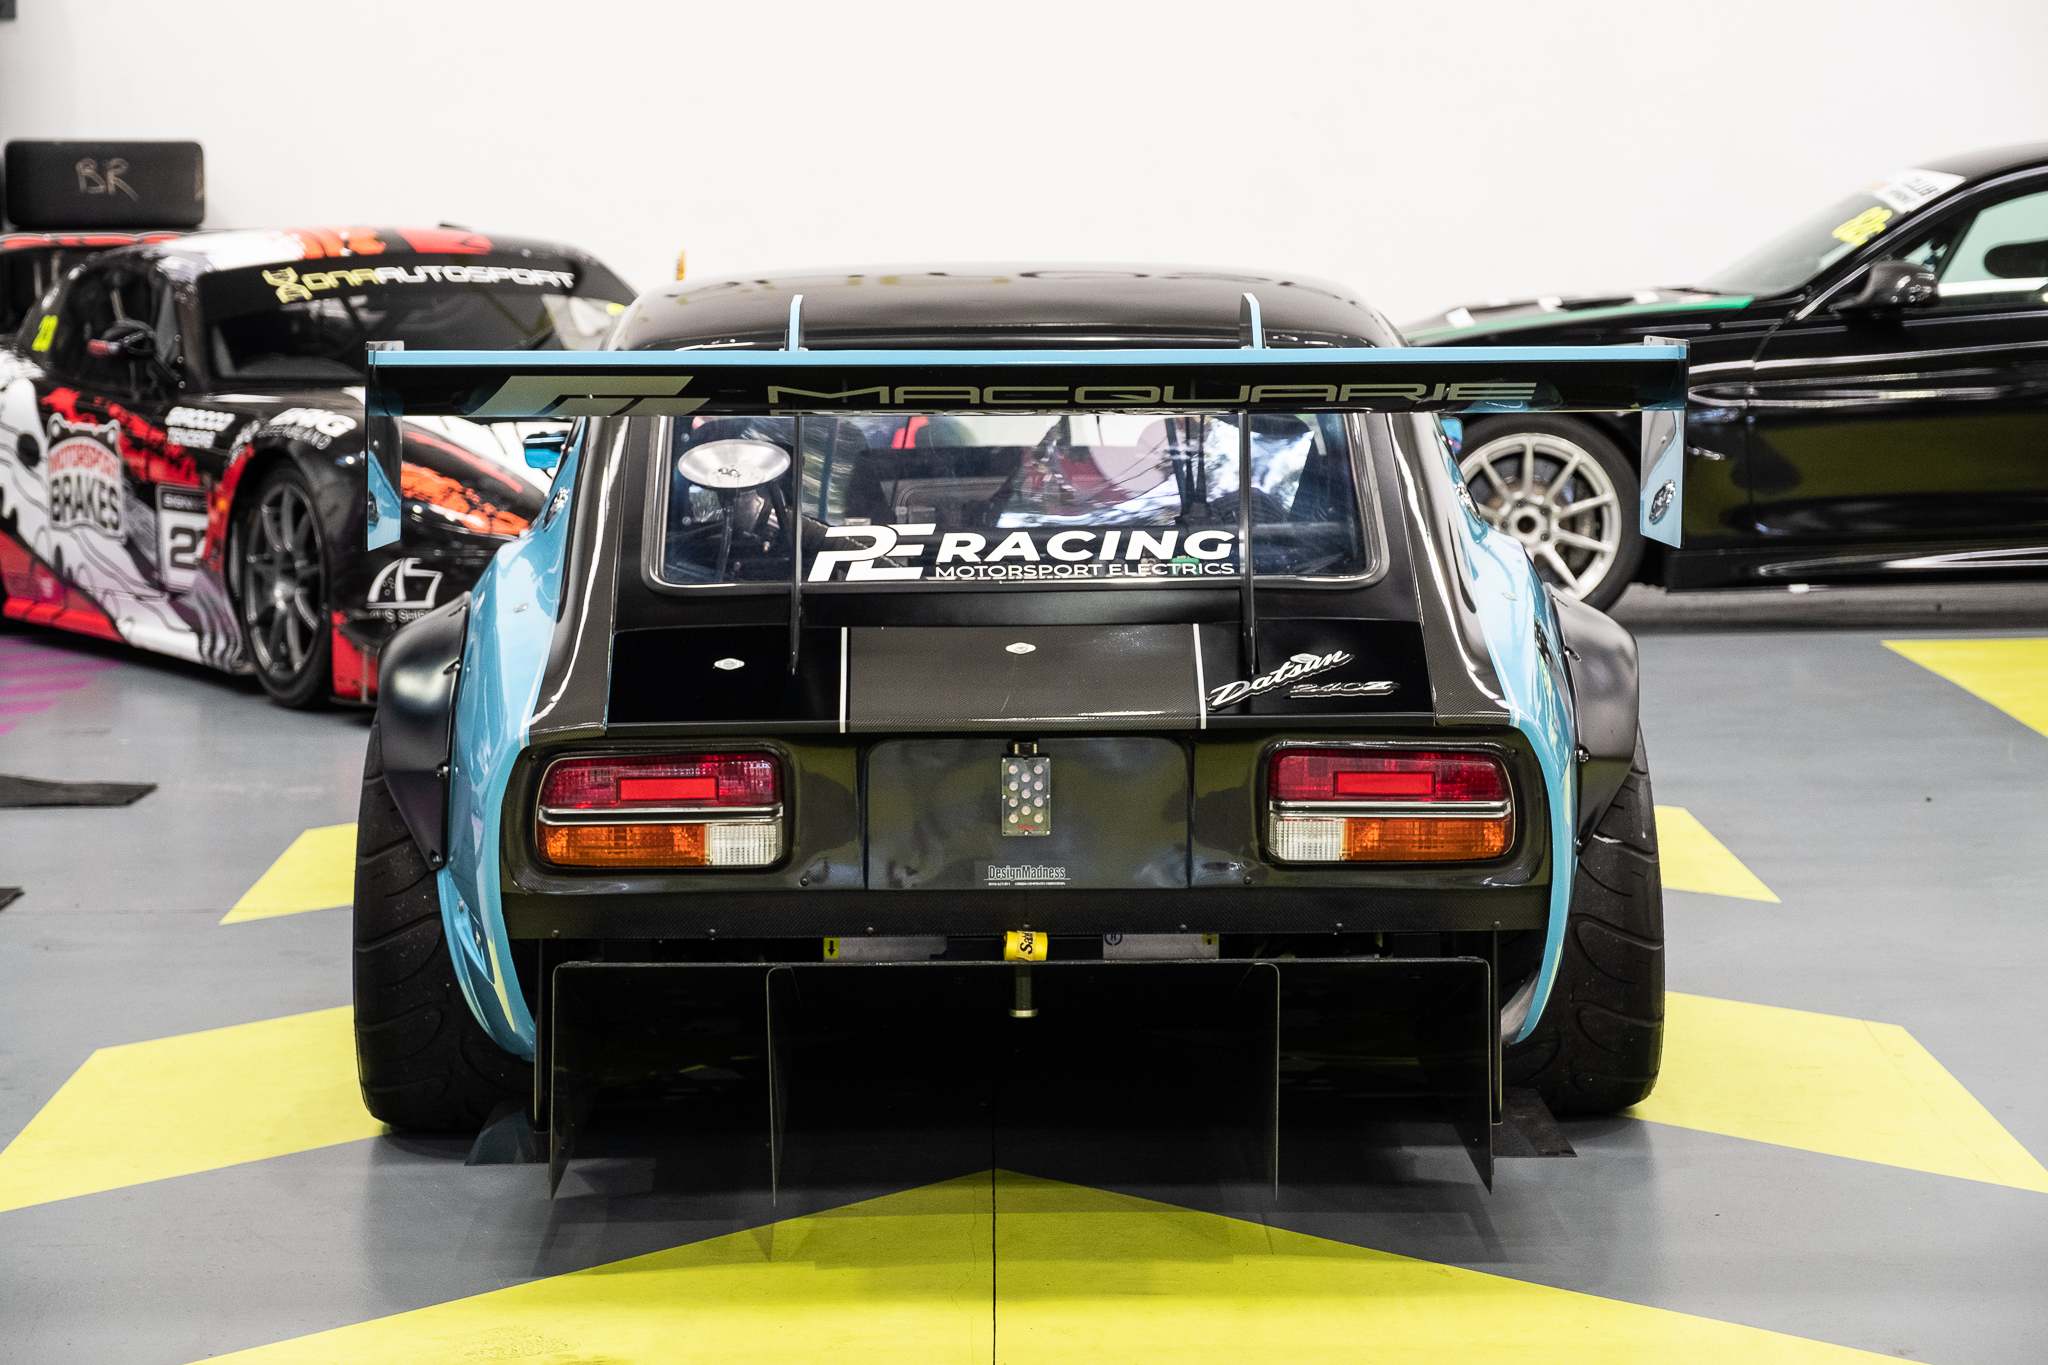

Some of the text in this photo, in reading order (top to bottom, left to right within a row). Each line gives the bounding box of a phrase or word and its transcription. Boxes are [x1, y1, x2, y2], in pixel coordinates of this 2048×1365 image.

[768, 381, 1538, 404] MACQUARIE
[51, 475, 121, 531] BRAKES
[936, 530, 1236, 564] RACING
[935, 563, 1235, 579] MOTORSPORT ELECTRICS
[1205, 651, 1354, 710] Datsun
[987, 865, 1066, 881] DesignMadness
